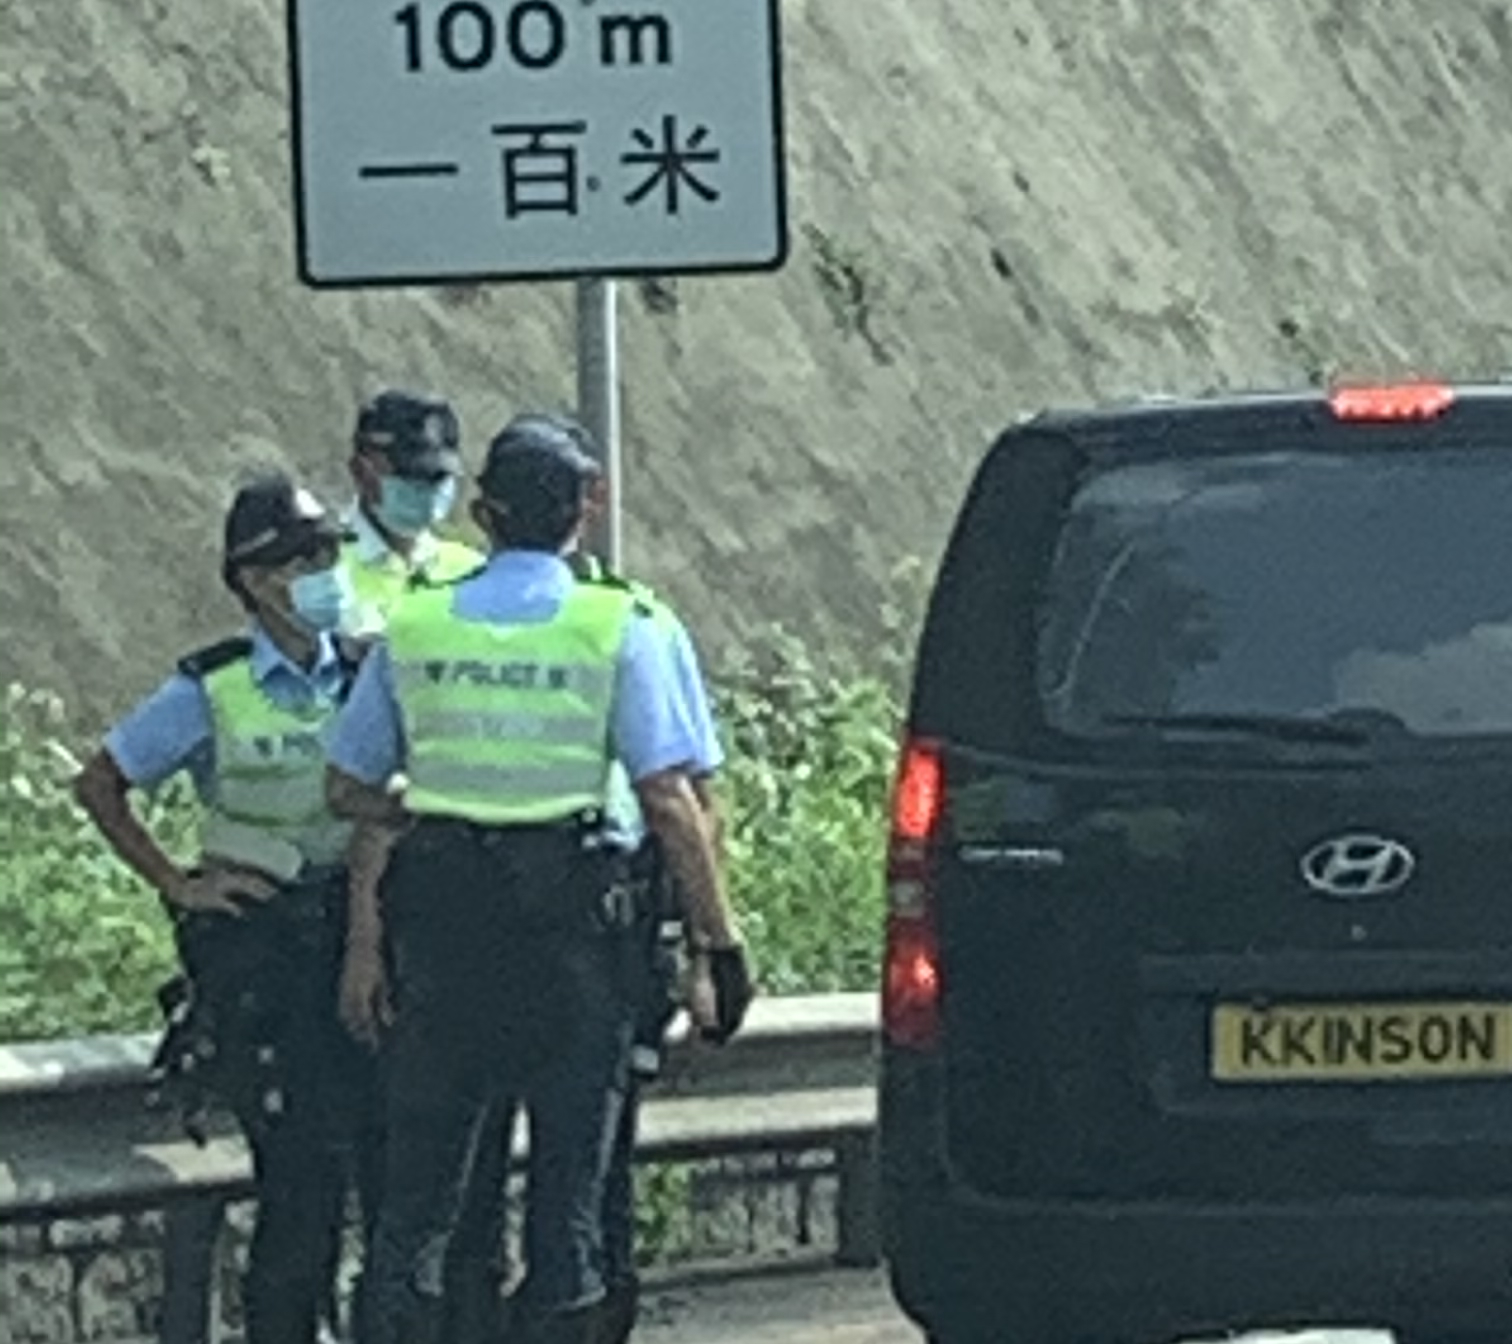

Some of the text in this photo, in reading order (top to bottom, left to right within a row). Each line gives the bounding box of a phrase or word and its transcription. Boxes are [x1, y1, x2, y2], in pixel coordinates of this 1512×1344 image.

[599, 12, 672, 66] m
[358, 114, 720, 218] 一百米
[1241, 1014, 1496, 1067] KKINSON
